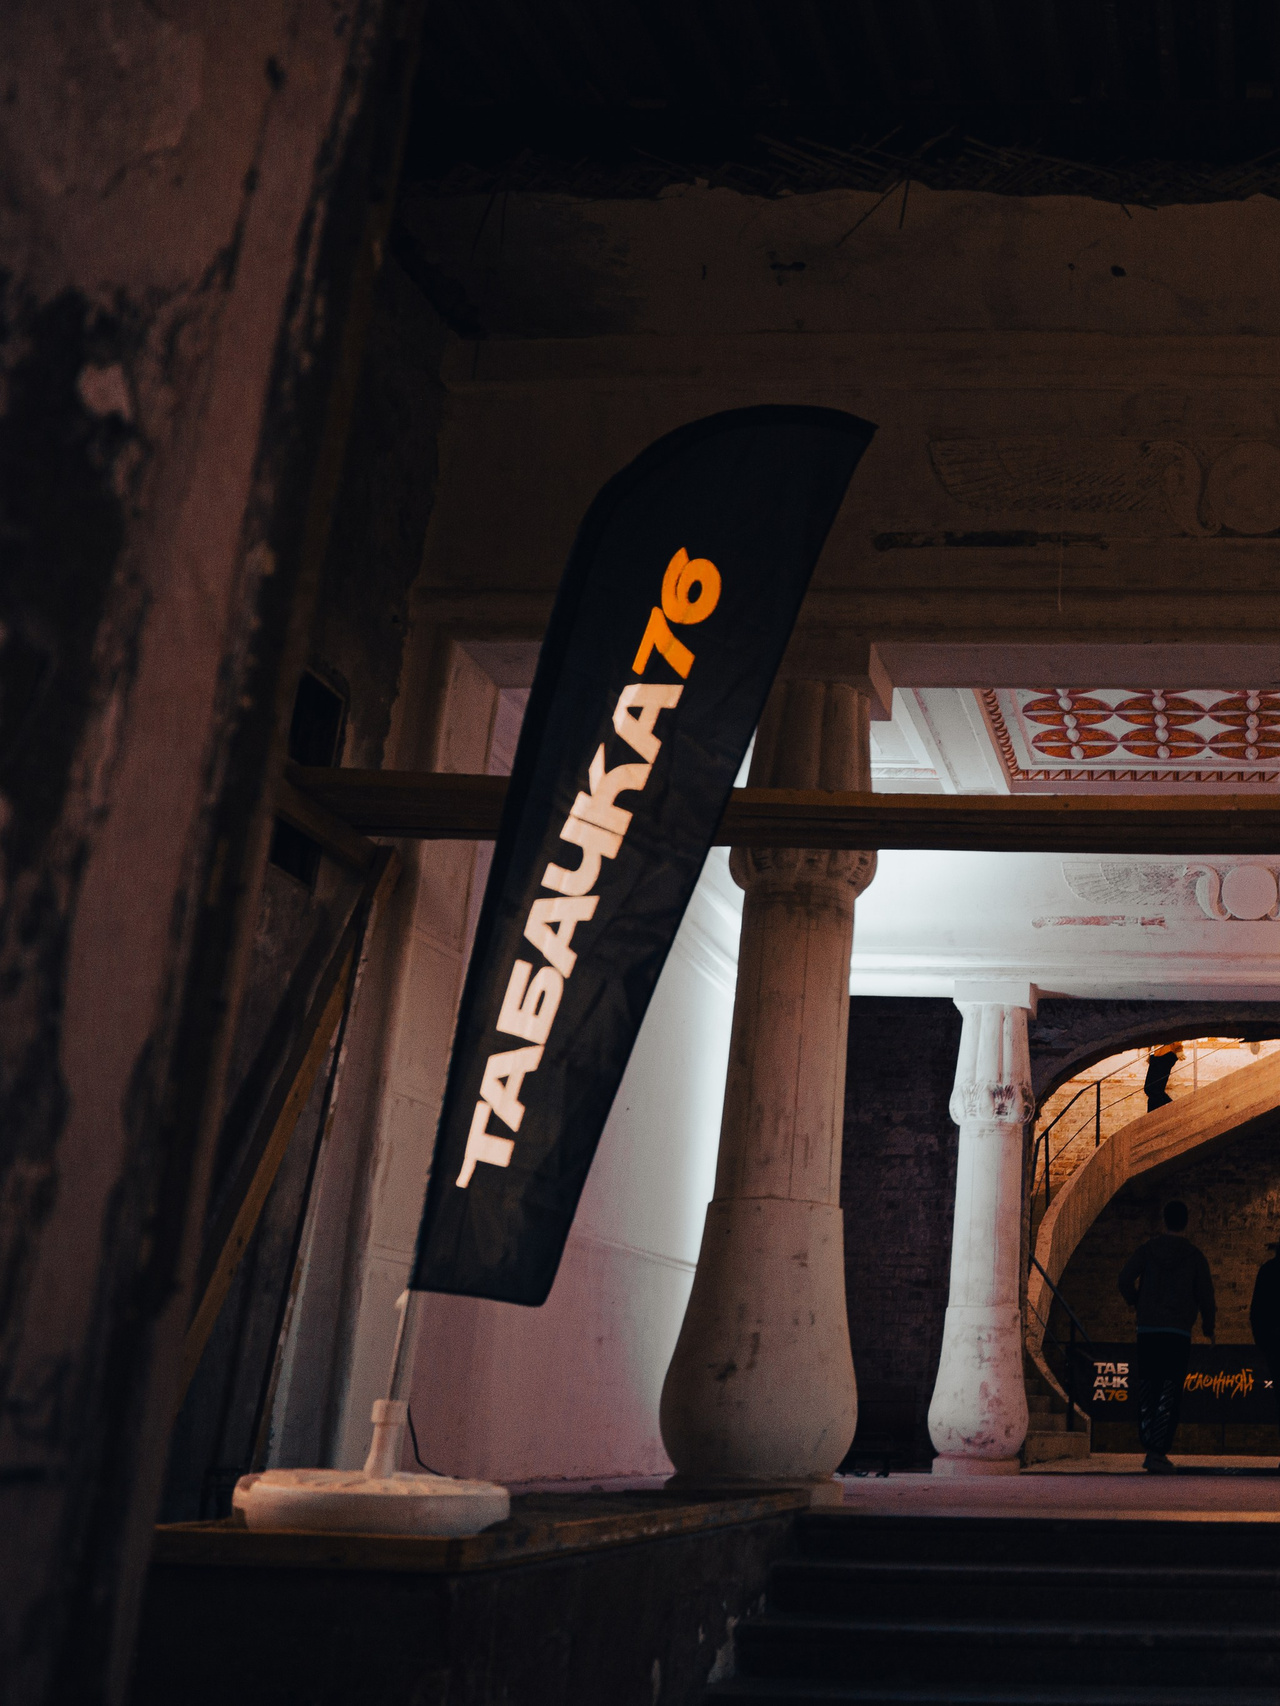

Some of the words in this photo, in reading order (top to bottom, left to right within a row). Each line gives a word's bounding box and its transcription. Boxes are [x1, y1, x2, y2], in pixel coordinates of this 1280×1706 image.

[455, 546, 722, 1189] ТАБАЧКА76
[1093, 1361, 1130, 1375] ТАБ
[1092, 1375, 1130, 1388] АЧК
[1092, 1388, 1129, 1402] А76
